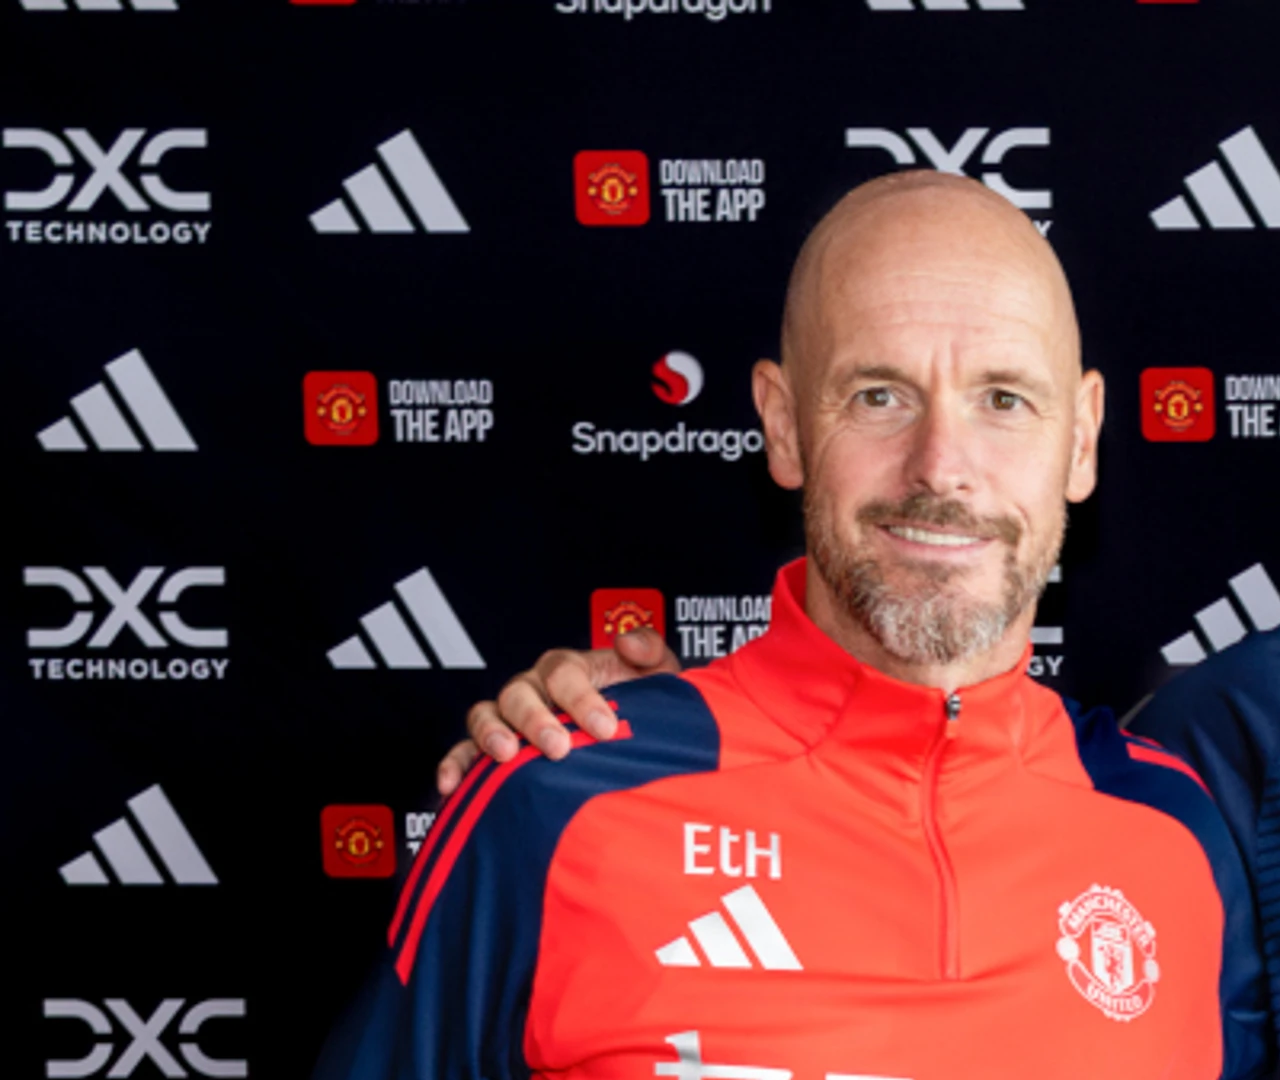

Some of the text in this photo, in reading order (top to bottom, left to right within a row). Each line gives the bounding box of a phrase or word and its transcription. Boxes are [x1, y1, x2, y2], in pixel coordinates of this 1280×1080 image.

[3, 129, 210, 211] DXC
[660, 159, 764, 185] DOWNLOAD
[662, 188, 765, 221] THE APP
[6, 221, 210, 243] TECHNOLOGY
[389, 380, 493, 405] DOWNLOAD
[391, 409, 493, 441] THE APP
[1226, 404, 1275, 437] THE
[573, 422, 764, 461] Snapdrago
[24, 567, 228, 647] DXC
[678, 625, 726, 658] THE
[29, 659, 228, 679] TECHNOLOGY
[684, 823, 781, 879] EtH
[44, 999, 247, 1078] DXC
